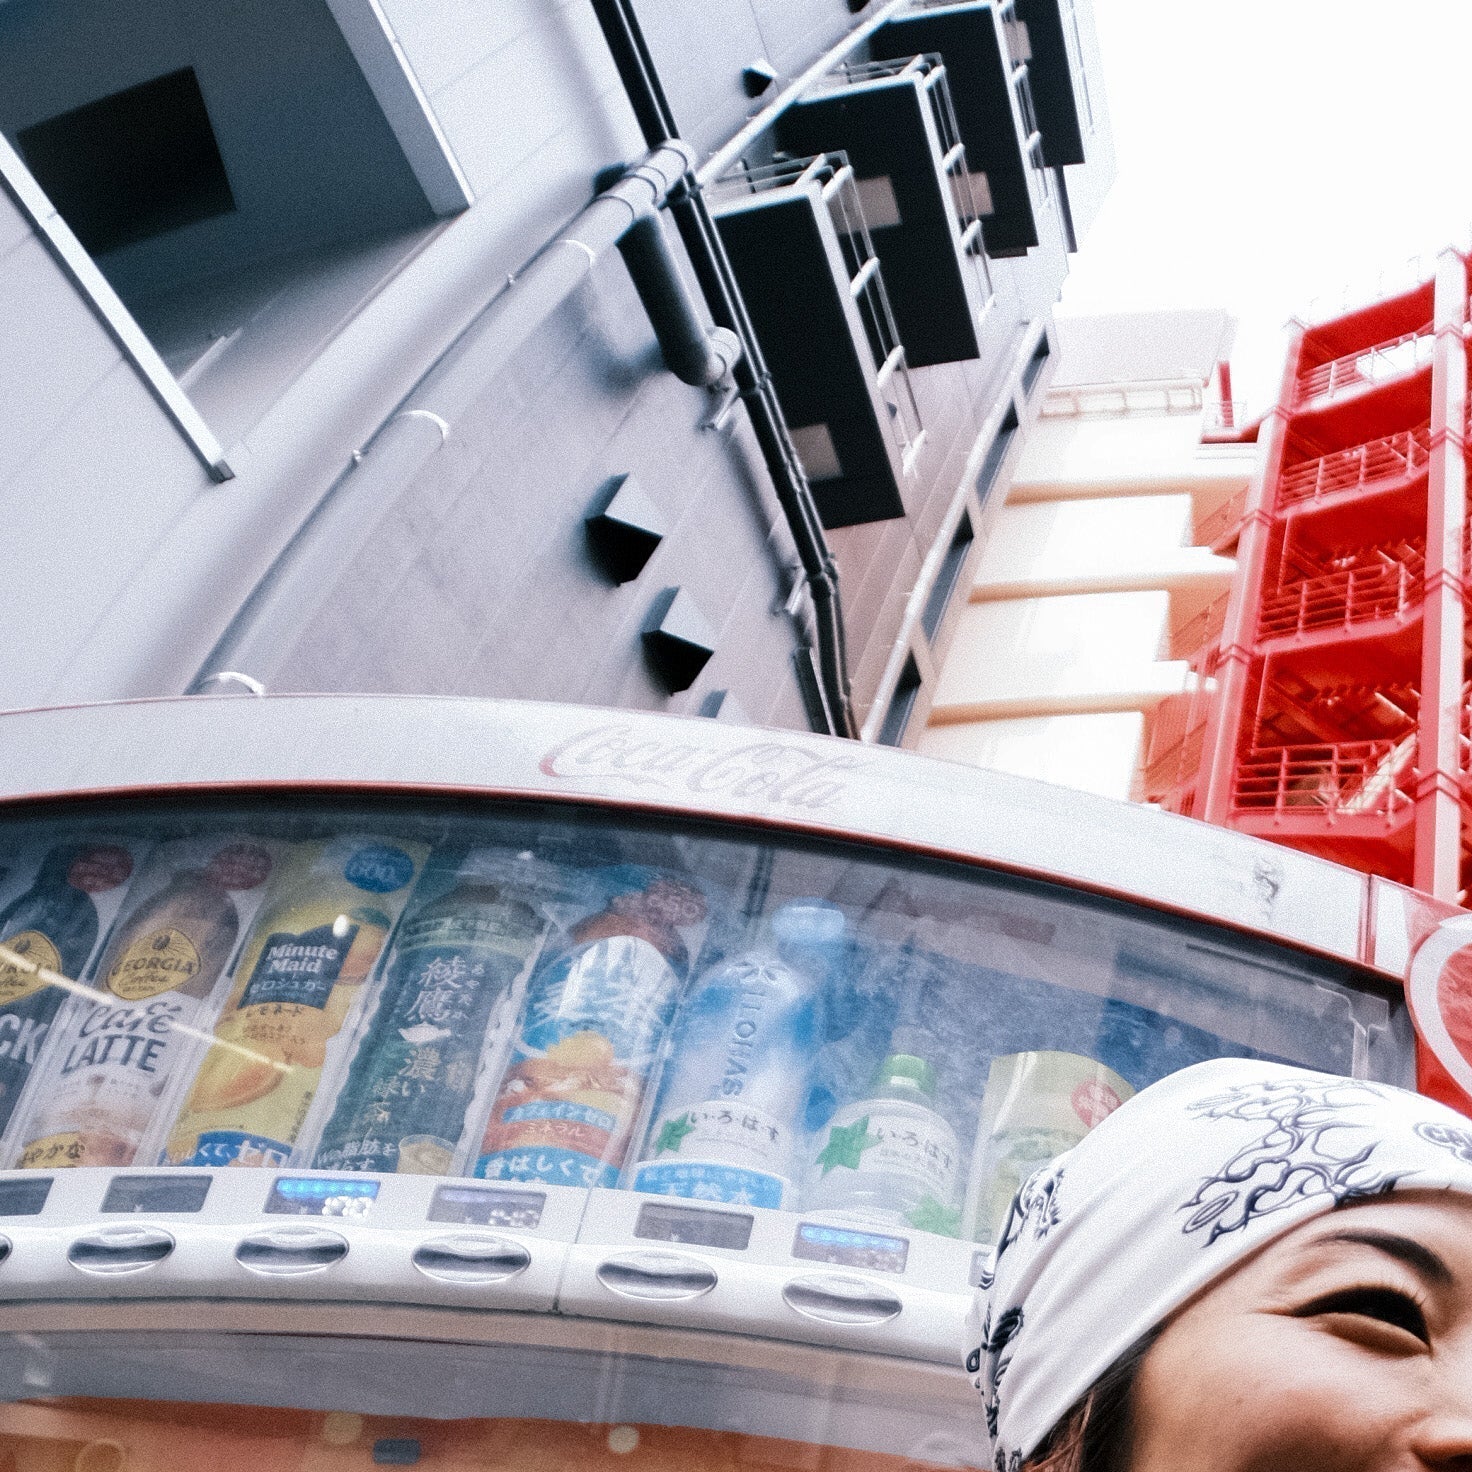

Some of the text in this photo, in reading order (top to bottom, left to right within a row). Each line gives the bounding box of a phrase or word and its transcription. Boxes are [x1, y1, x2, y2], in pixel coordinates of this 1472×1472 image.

[267, 942, 340, 962] Minute
[270, 957, 323, 975] Maid
[61, 1033, 166, 1074] LATTE
